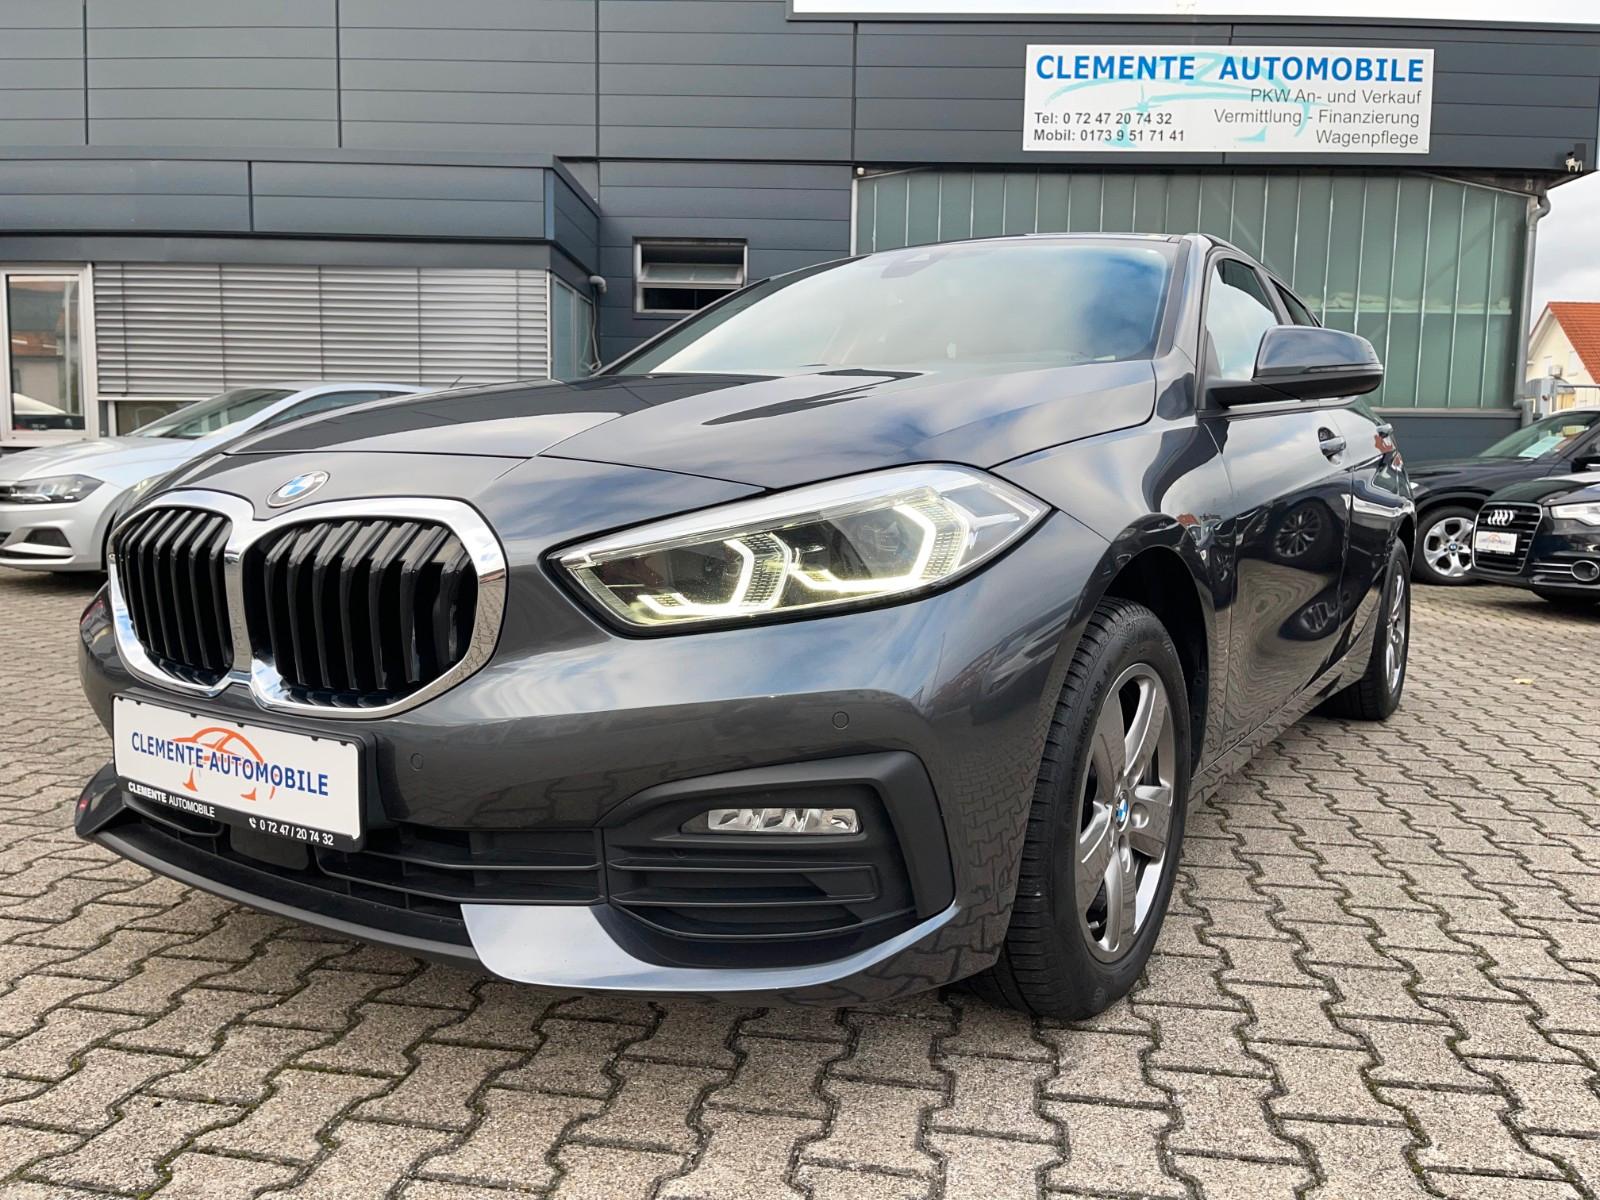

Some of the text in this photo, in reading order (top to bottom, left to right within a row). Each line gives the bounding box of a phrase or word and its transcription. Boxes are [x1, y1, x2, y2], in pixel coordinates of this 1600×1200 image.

[1036, 55, 1424, 82] CLEMENTE AUTOMOBILE
[1251, 88, 1422, 104] PKW An- und Verkauf
[1034, 112, 1173, 125] Tel: 0 72 47 20 74 32
[1214, 109, 1302, 126] Vermittlung
[1318, 110, 1420, 128] Finanzierung
[1034, 129, 1184, 142] Mobil: 0173 9 51 71 41
[1316, 130, 1419, 148] Wagenpflege
[131, 732, 329, 796] CLEMENTE AUTOMOBILE
[128, 782, 215, 818] CLEMENTE AUTOMOBILE
[259, 819, 266, 831] 0
[267, 821, 278, 833] 72
[279, 824, 290, 836] 47
[296, 828, 308, 840] 20
[309, 831, 320, 843] 74
[322, 833, 334, 846] 32
